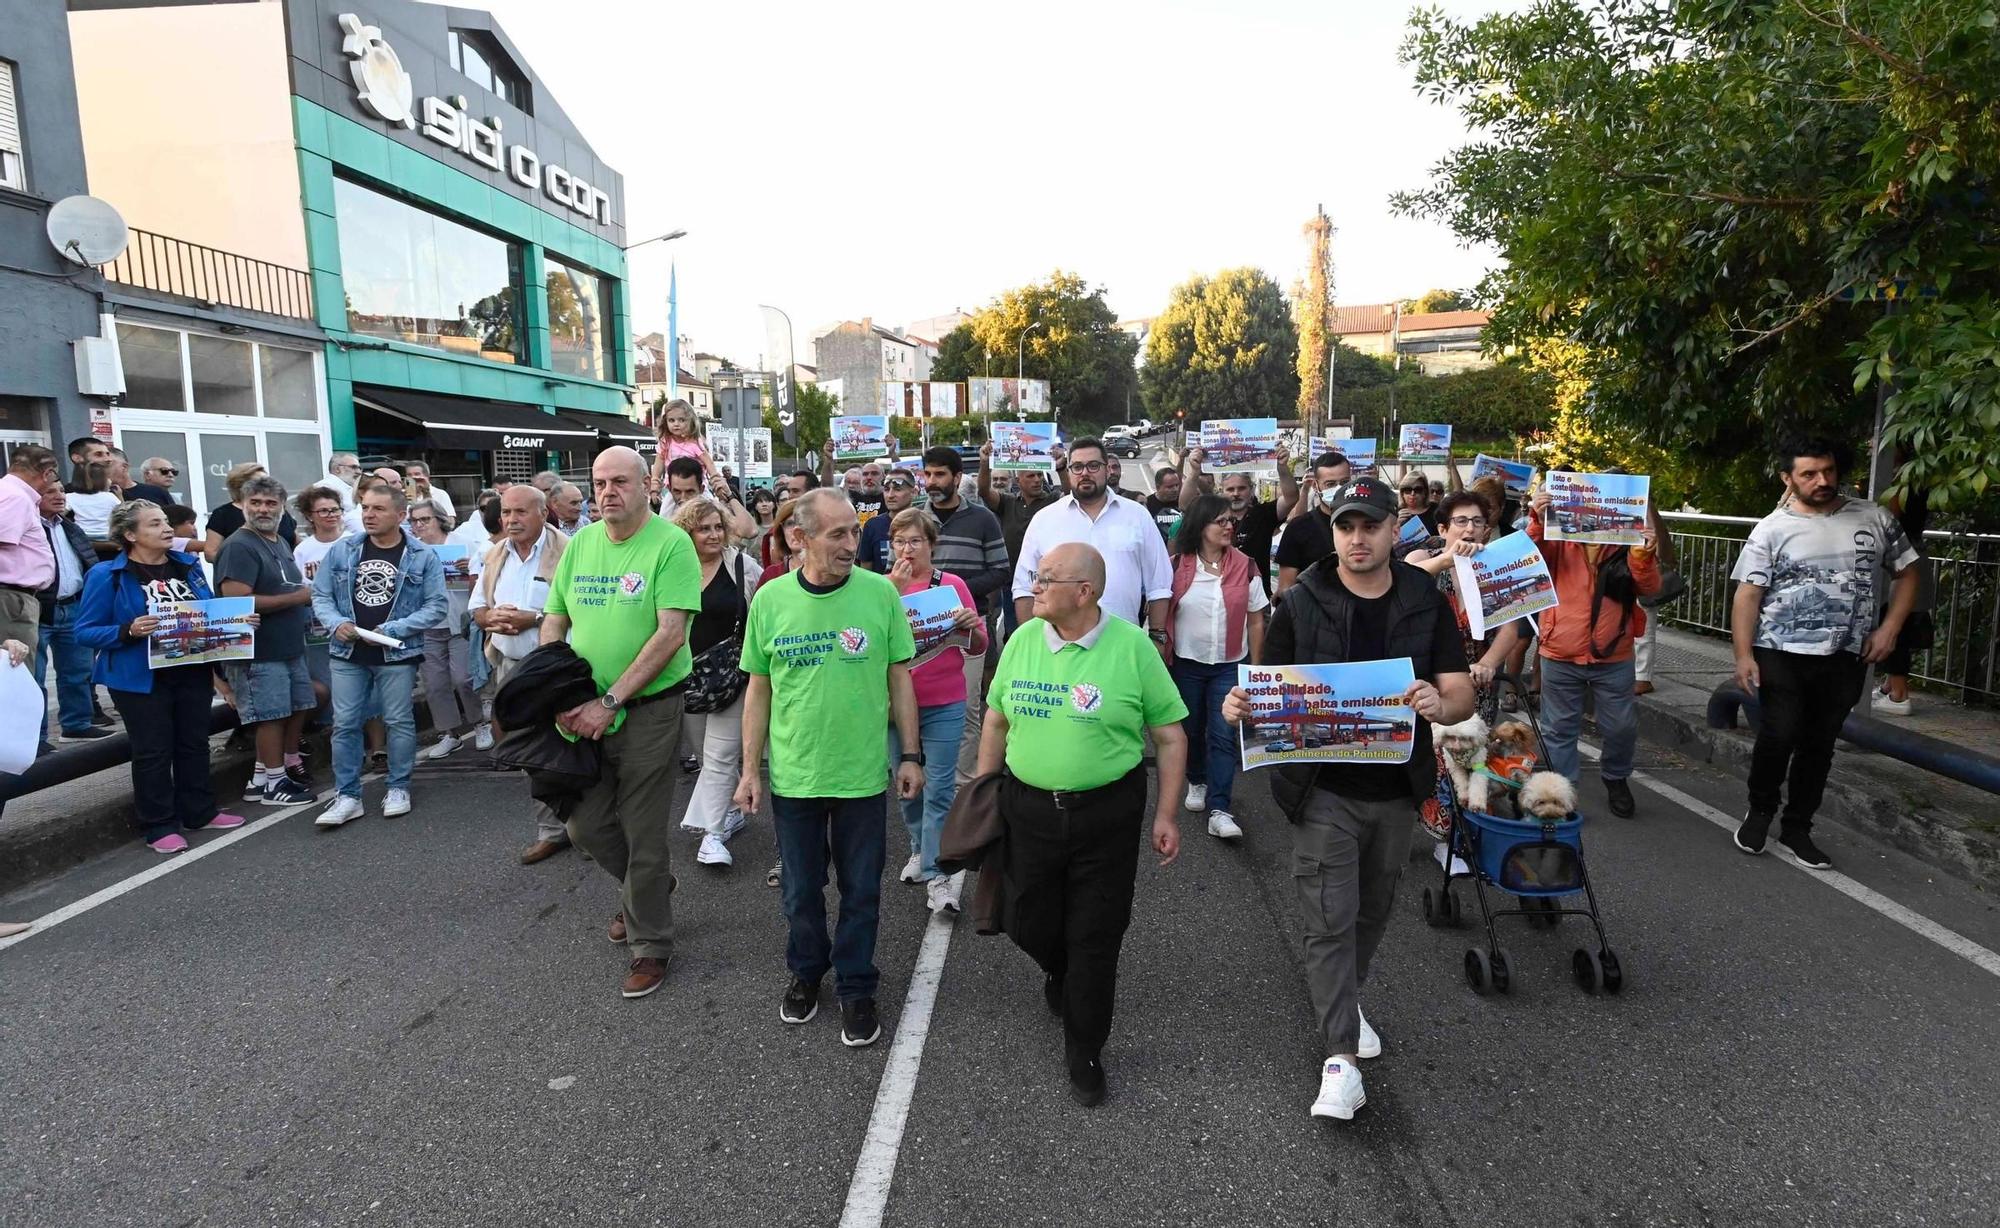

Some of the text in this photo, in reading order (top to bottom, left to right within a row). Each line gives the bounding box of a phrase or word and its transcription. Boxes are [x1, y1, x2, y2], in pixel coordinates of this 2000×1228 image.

[422, 94, 612, 226] Bici o con
[511, 438, 544, 448] GIANT
[1582, 496, 1602, 504] baixa
[1604, 496, 1637, 505] emisións
[1494, 556, 1532, 576] emisións
[574, 576, 620, 584] BRIGADAS
[356, 590, 389, 604] DIXEN
[576, 597, 607, 606] FAVEC
[159, 612, 208, 621] ostebilidade,
[210, 617, 244, 626] emisións
[774, 630, 837, 646] BRIGADAS
[777, 643, 834, 658] VECIÑAIS
[788, 656, 824, 668] FAVEC
[1248, 670, 1282, 683] Isto e
[1012, 680, 1069, 694] BRIGADAS
[1244, 682, 1335, 696] sostebilidade,
[1010, 692, 1063, 706] VECIÑAIS
[1286, 699, 1300, 710] de
[1306, 698, 1338, 710] baixa
[1342, 696, 1400, 708] emisións
[1404, 697, 1410, 706] e
[1014, 706, 1052, 718] FAVEC
[1338, 750, 1350, 759] do
